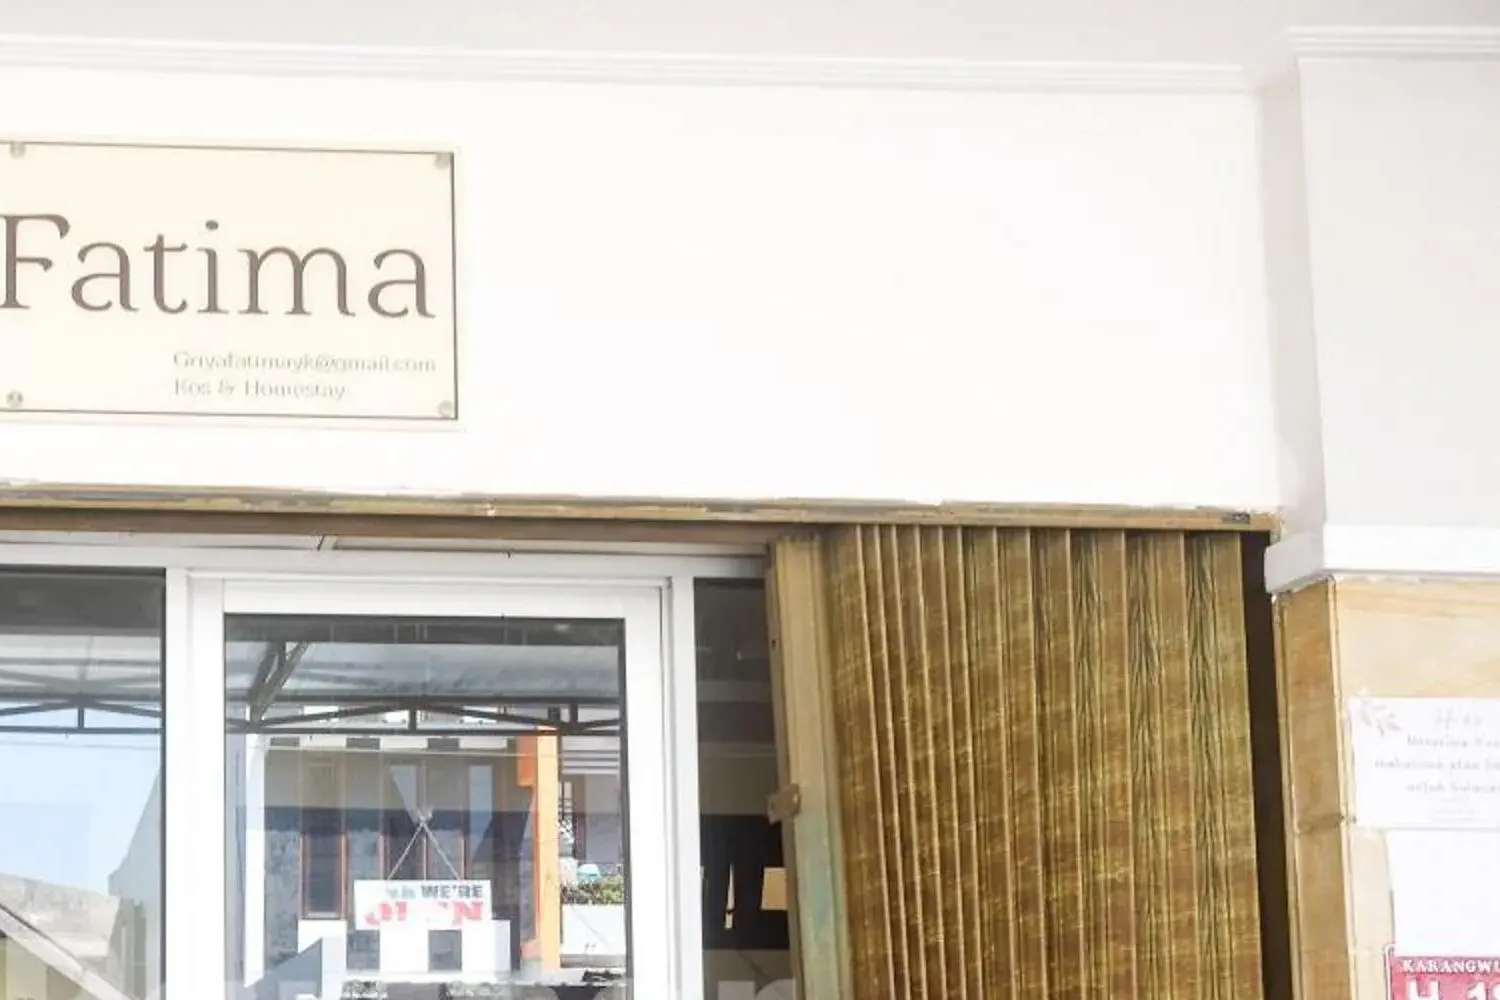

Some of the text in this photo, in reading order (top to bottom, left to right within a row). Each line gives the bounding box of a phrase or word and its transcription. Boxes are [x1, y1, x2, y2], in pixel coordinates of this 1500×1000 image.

[173, 378, 347, 401] Kos & Homestay
